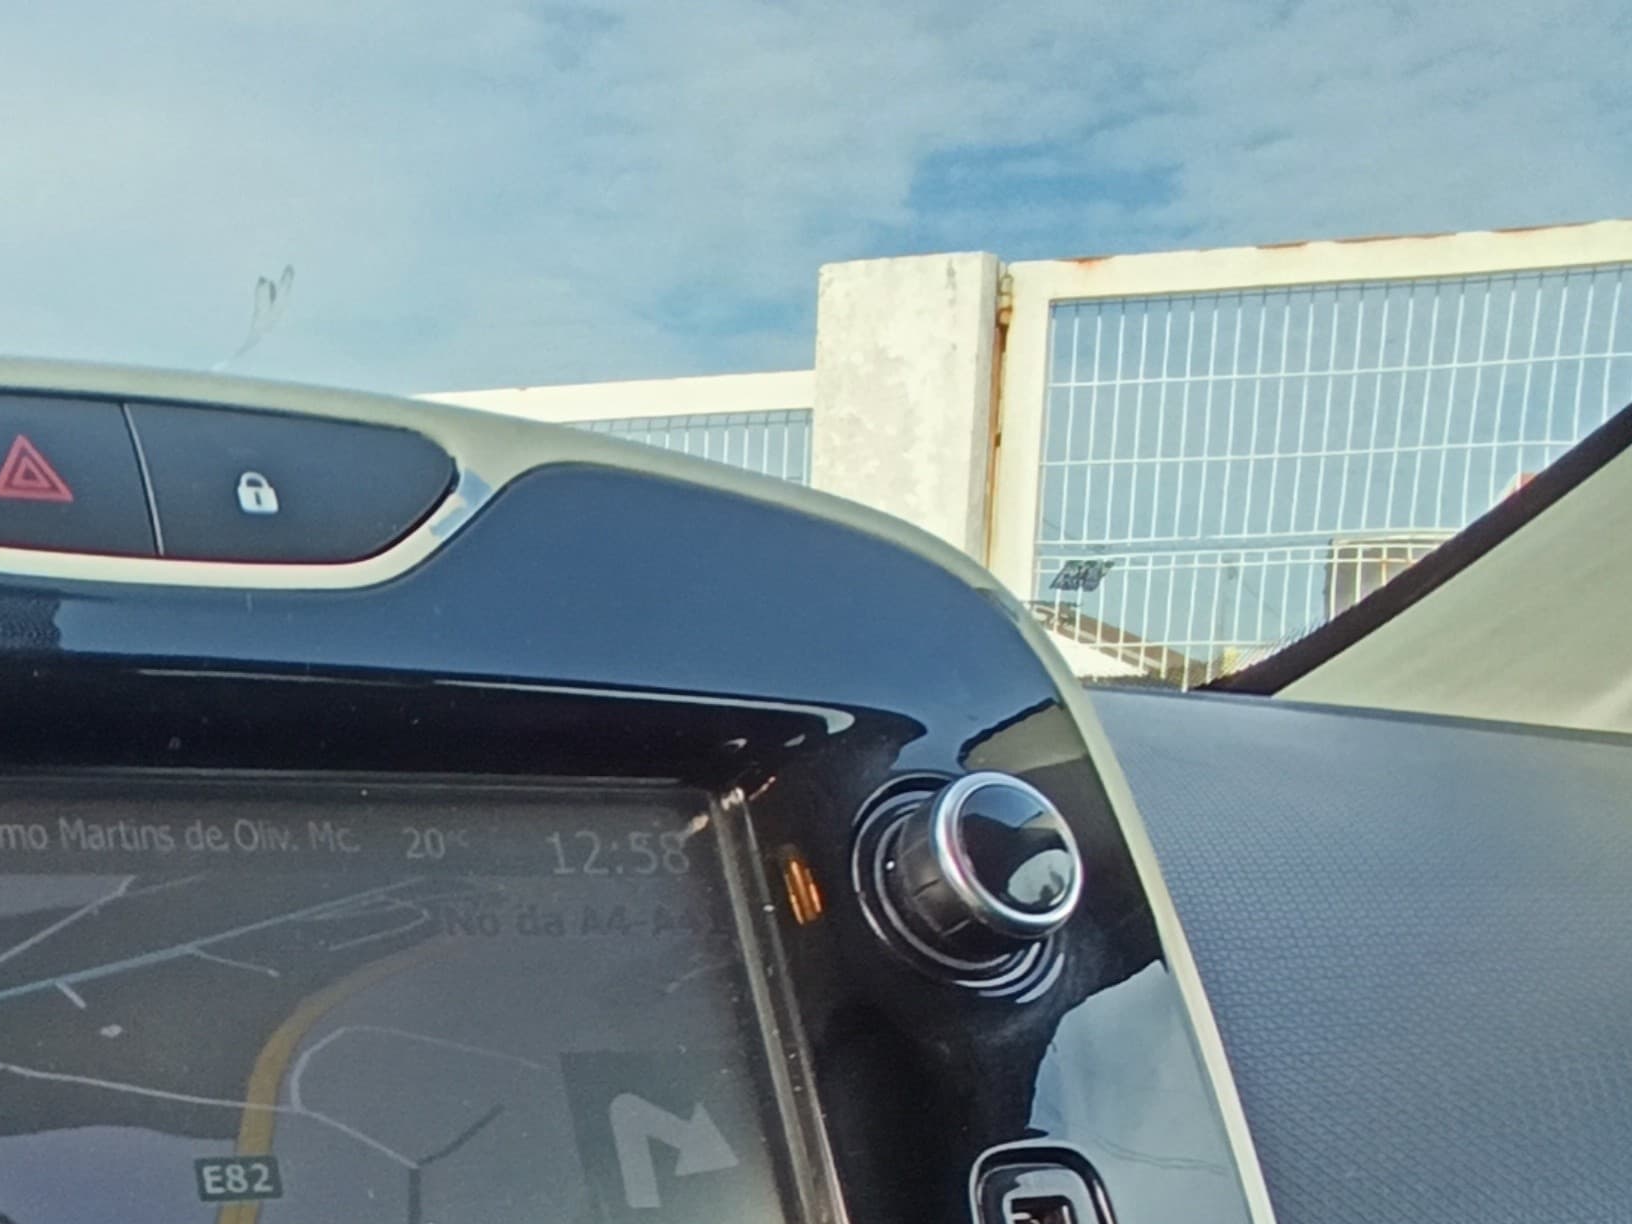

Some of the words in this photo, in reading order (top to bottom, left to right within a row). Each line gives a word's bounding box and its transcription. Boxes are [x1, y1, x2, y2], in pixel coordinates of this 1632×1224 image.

[59, 816, 172, 852] Martins
[185, 818, 229, 852] de
[544, 829, 691, 876] 12:58
[202, 1160, 275, 1194] E82
